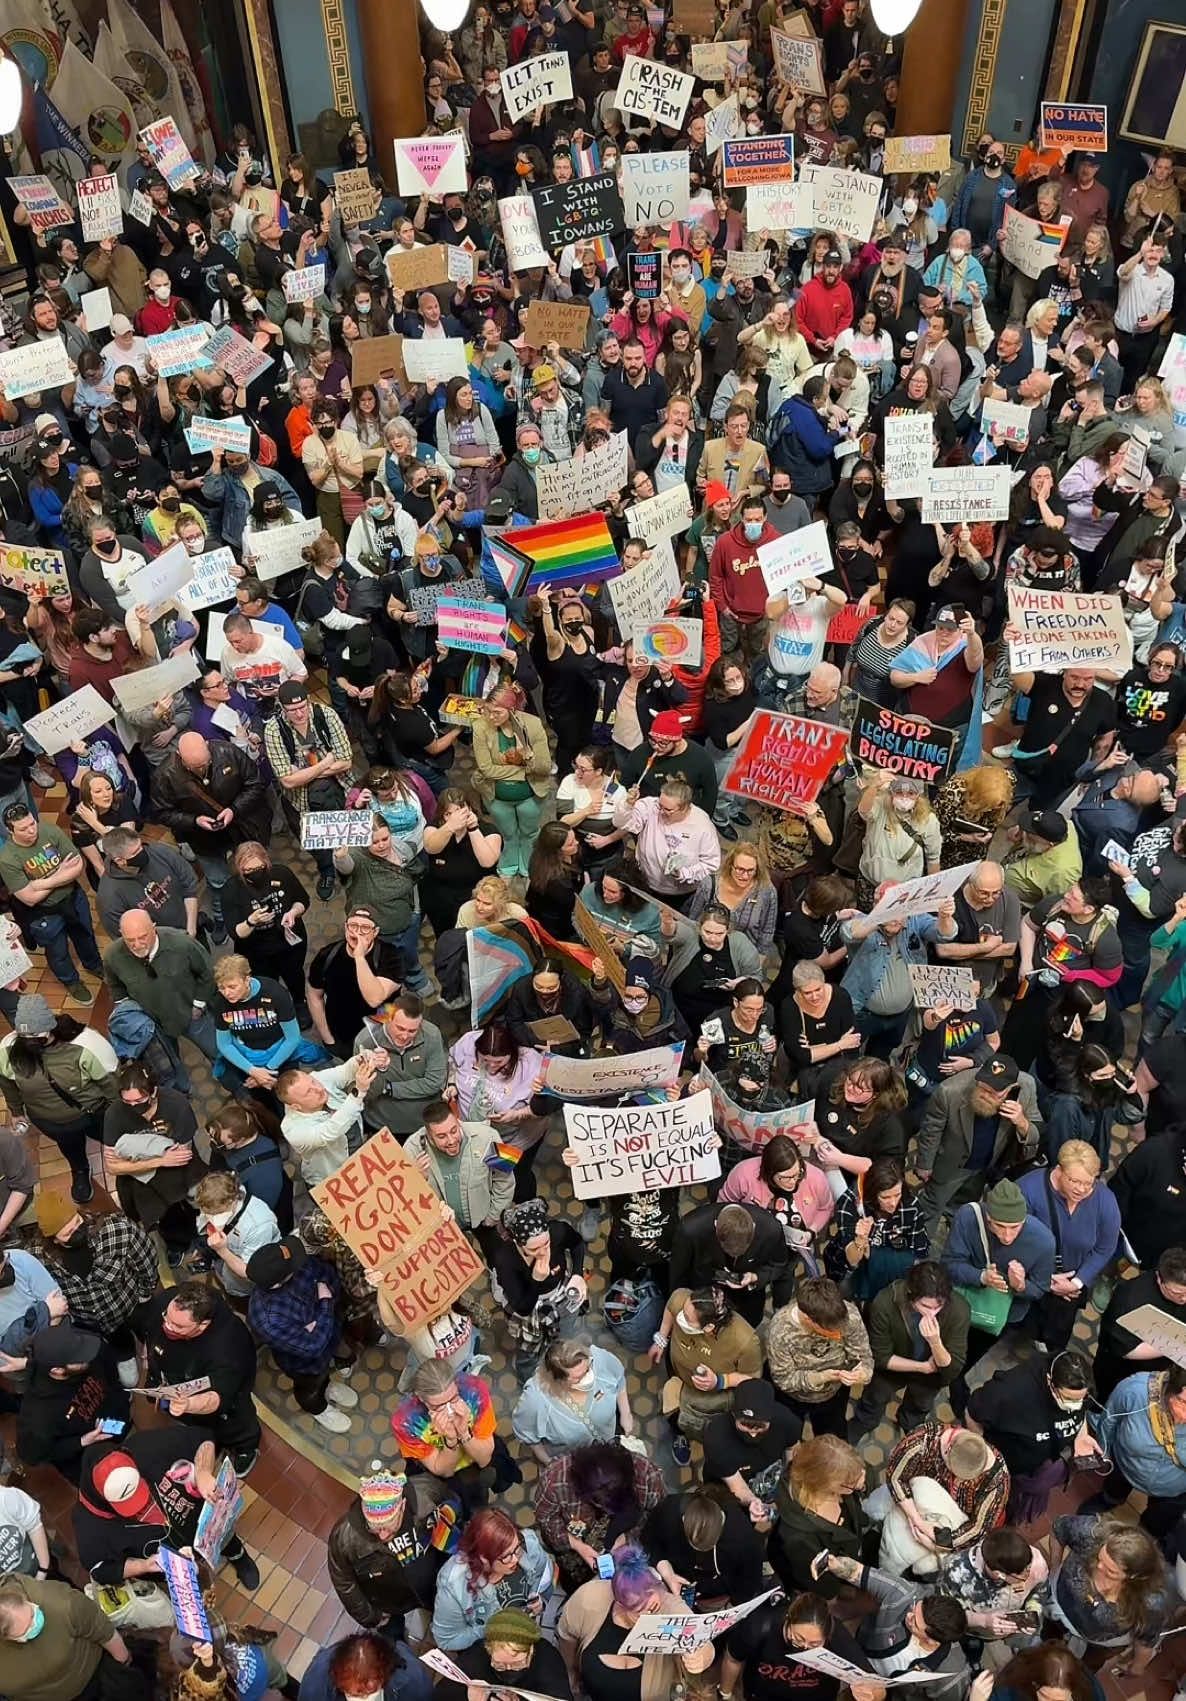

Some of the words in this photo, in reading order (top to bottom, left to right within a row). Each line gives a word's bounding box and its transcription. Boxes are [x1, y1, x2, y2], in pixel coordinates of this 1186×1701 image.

[507, 63, 535, 89] LET
[630, 61, 683, 91] CRASH
[515, 81, 553, 112] EXIST
[641, 85, 666, 98] THE
[1045, 109, 1065, 121] NO
[1068, 110, 1104, 123] HATE
[729, 140, 784, 152] STANDING
[1056, 134, 1075, 142] OUR
[1077, 135, 1104, 144] STATE
[628, 157, 688, 174] PLEASE
[729, 151, 786, 162] TOGETHER
[78, 176, 115, 196] REJECT
[540, 189, 553, 206] I
[567, 178, 614, 200] STAND
[633, 182, 673, 197] VOTE
[802, 169, 820, 183] I
[832, 174, 879, 196] STAND
[562, 196, 598, 212] WITH
[825, 189, 853, 200] WITH
[31, 209, 70, 226] RIGHTS
[343, 203, 374, 221] SAFETY
[636, 200, 674, 221] NO
[549, 218, 614, 246] IOWANS
[817, 214, 860, 235] OWANS
[640, 272, 651, 280] ARE
[537, 307, 551, 317] NO
[205, 331, 232, 354] TRANS
[934, 499, 991, 510] RESISTANCE
[732, 556, 761, 576] Cyclo
[456, 599, 485, 611] TRANS
[1011, 588, 1064, 610] WHEN
[1076, 597, 1112, 610] DID
[454, 610, 489, 621] RIGHTS
[1024, 611, 1107, 630] FREEDOM
[456, 630, 488, 642] HUMAN
[1013, 630, 1066, 646] BECOME
[1071, 630, 1116, 641] TAKING
[454, 640, 488, 653] RIGHTS
[768, 717, 833, 750] TRANS
[879, 710, 931, 741] STOP
[762, 736, 825, 766] RIGHTS
[860, 718, 949, 765] LEGISLATING
[759, 752, 794, 768] ARE
[859, 739, 943, 781] BIGOTRY
[750, 761, 814, 797] HUMAN
[739, 777, 804, 808] RIGHTS
[306, 812, 370, 825] TRANSGENDER
[306, 823, 371, 838] LIVES
[917, 966, 970, 977] TRANS
[914, 987, 971, 999] HUMAN
[928, 982, 956, 990] ARE
[574, 1105, 688, 1140] SEPARATE
[590, 1140, 607, 1157] IS
[614, 1134, 652, 1155] NOT
[658, 1116, 714, 1149] EQUAL!
[577, 1157, 625, 1183] IT'S
[628, 1141, 716, 1172] FUCKING
[325, 1143, 396, 1210] REAL
[642, 1166, 707, 1190] EVIL
[355, 1175, 408, 1232] GOP
[359, 1199, 423, 1267] DON'T
[383, 1219, 461, 1292] SUPPORT
[394, 1245, 480, 1323] BIGOTRY
[439, 1317, 467, 1348] TEAM
[661, 1616, 700, 1627] THE
